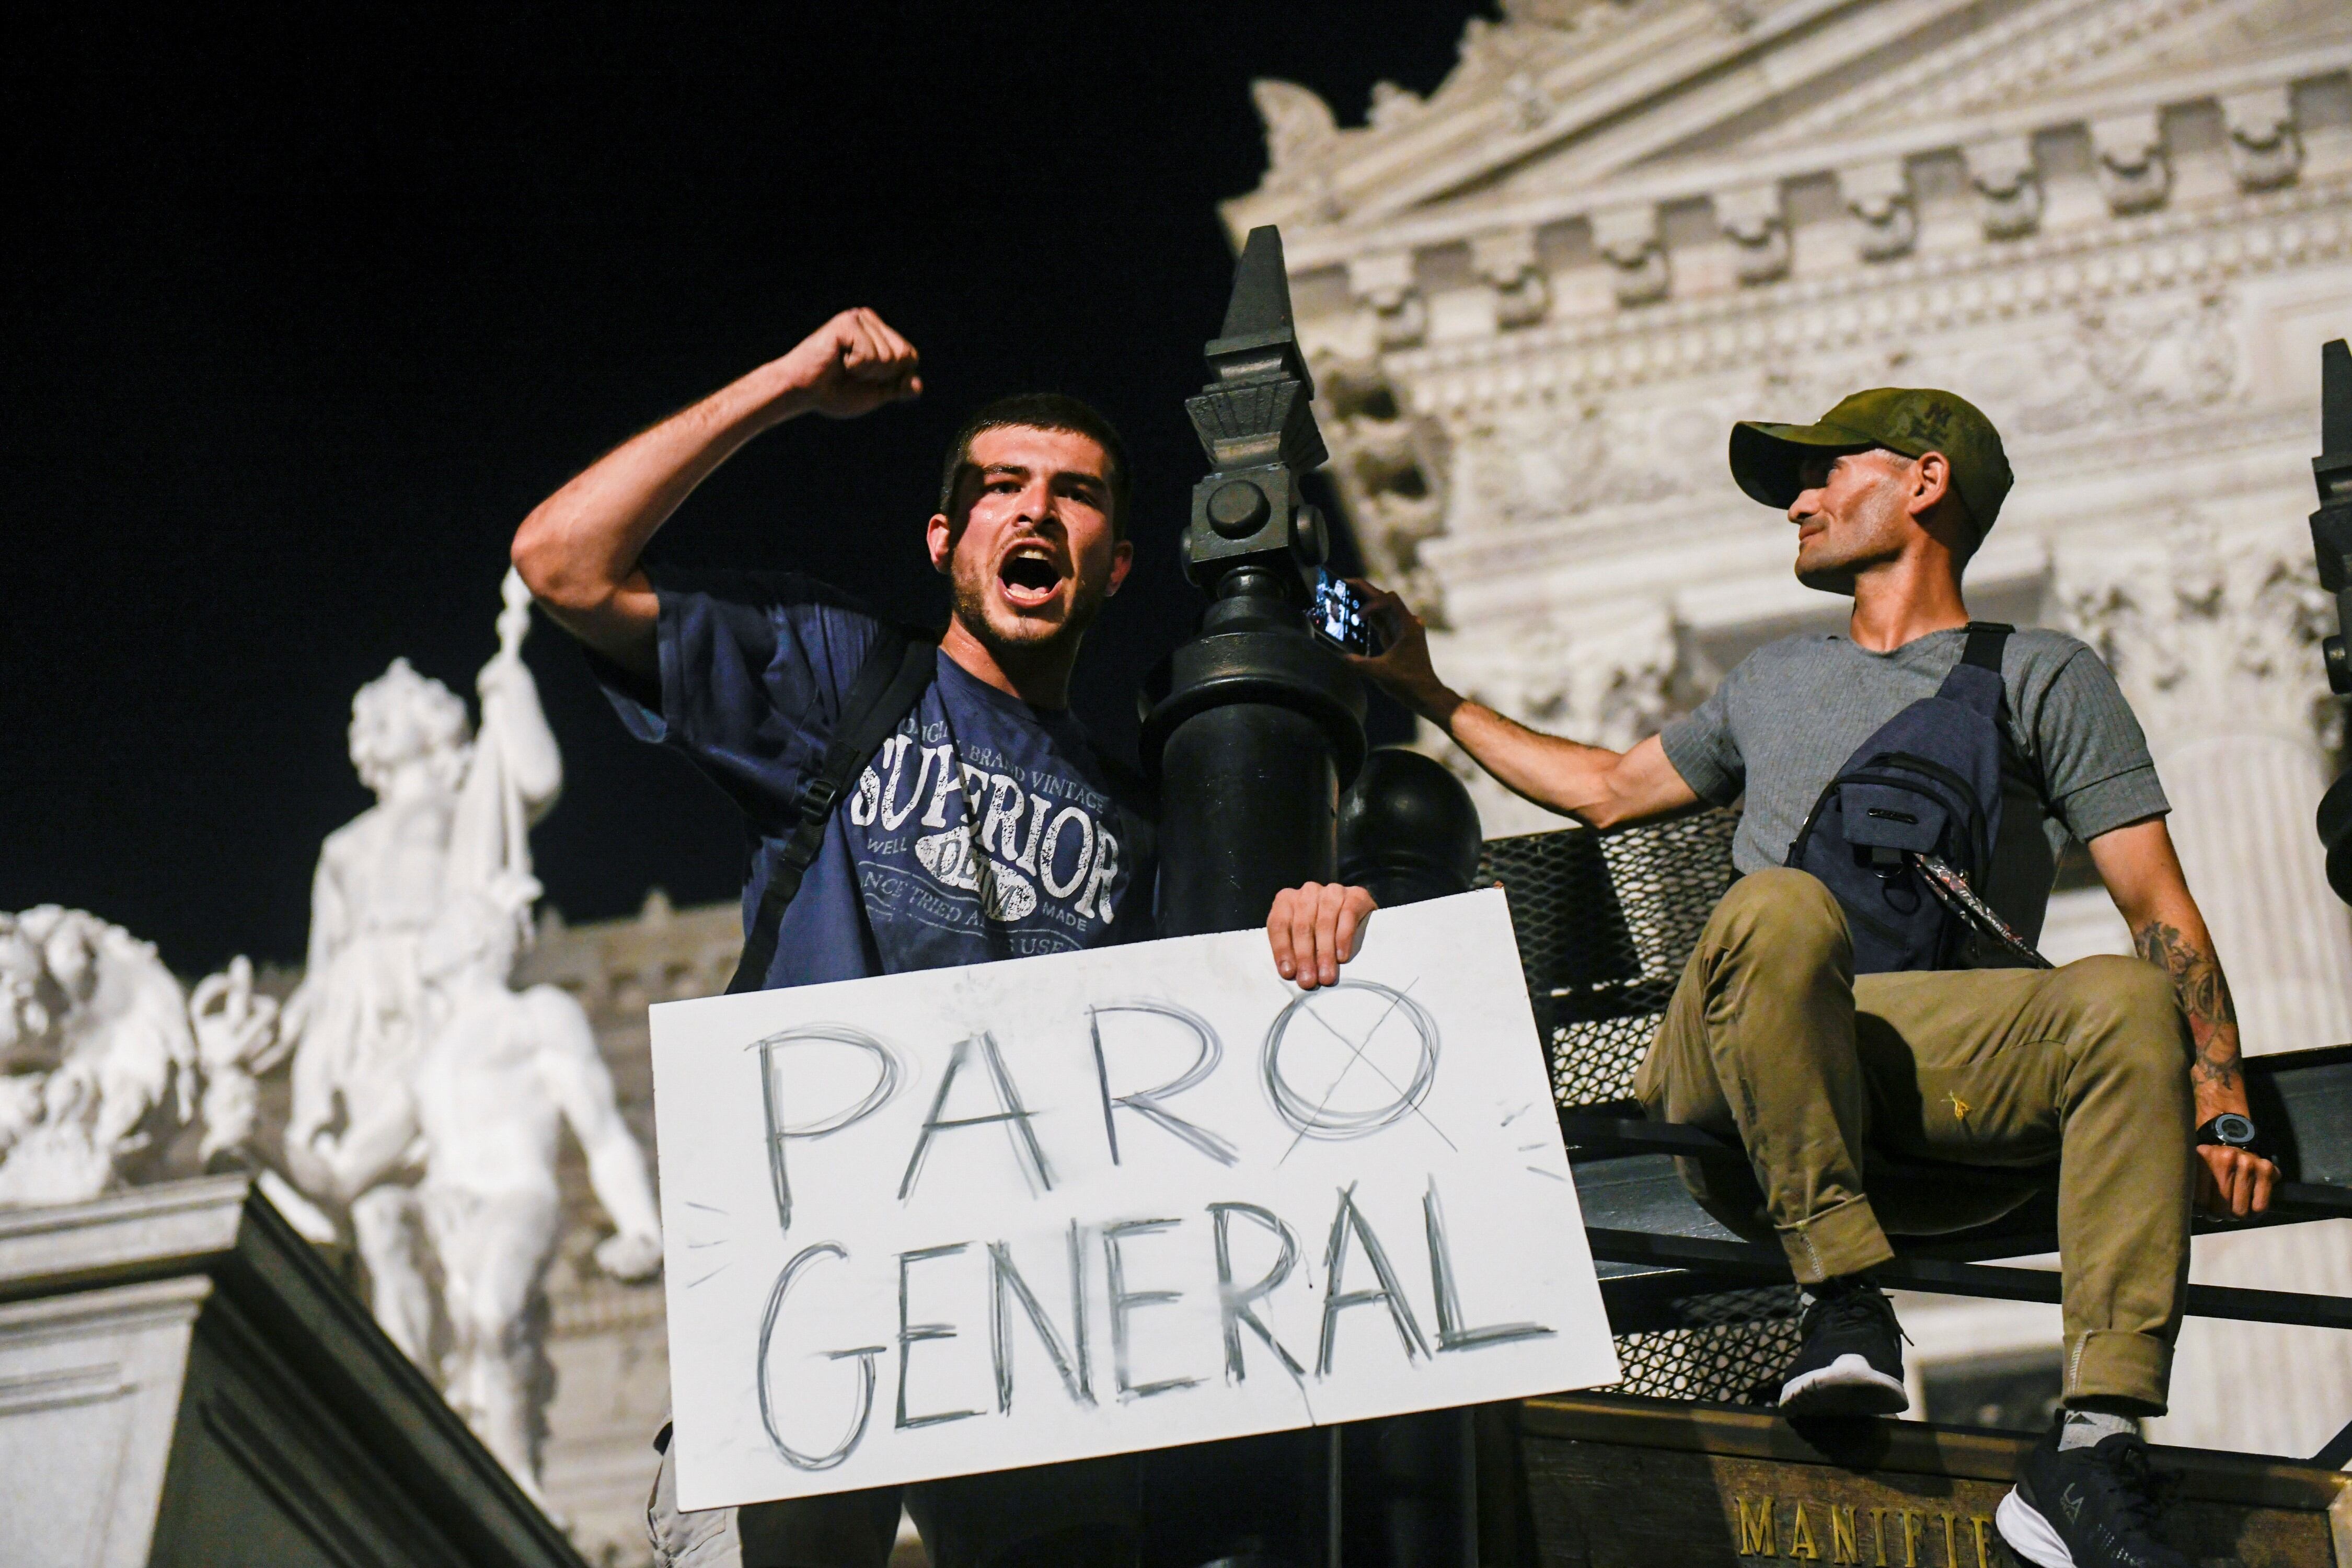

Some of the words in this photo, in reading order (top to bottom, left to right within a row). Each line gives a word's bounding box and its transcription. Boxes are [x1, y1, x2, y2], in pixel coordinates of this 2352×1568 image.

[969, 744, 1025, 782] BRAND
[1031, 771, 1107, 814] VINTAGE
[867, 837, 907, 855] WELL
[860, 871, 908, 898] NCE
[909, 886, 962, 922] TRIED
[1042, 902, 1087, 932] MADE
[1021, 938, 1076, 954] USE
[746, 977, 1443, 1236] PARO
[757, 1175, 1558, 1471] GENERAL
